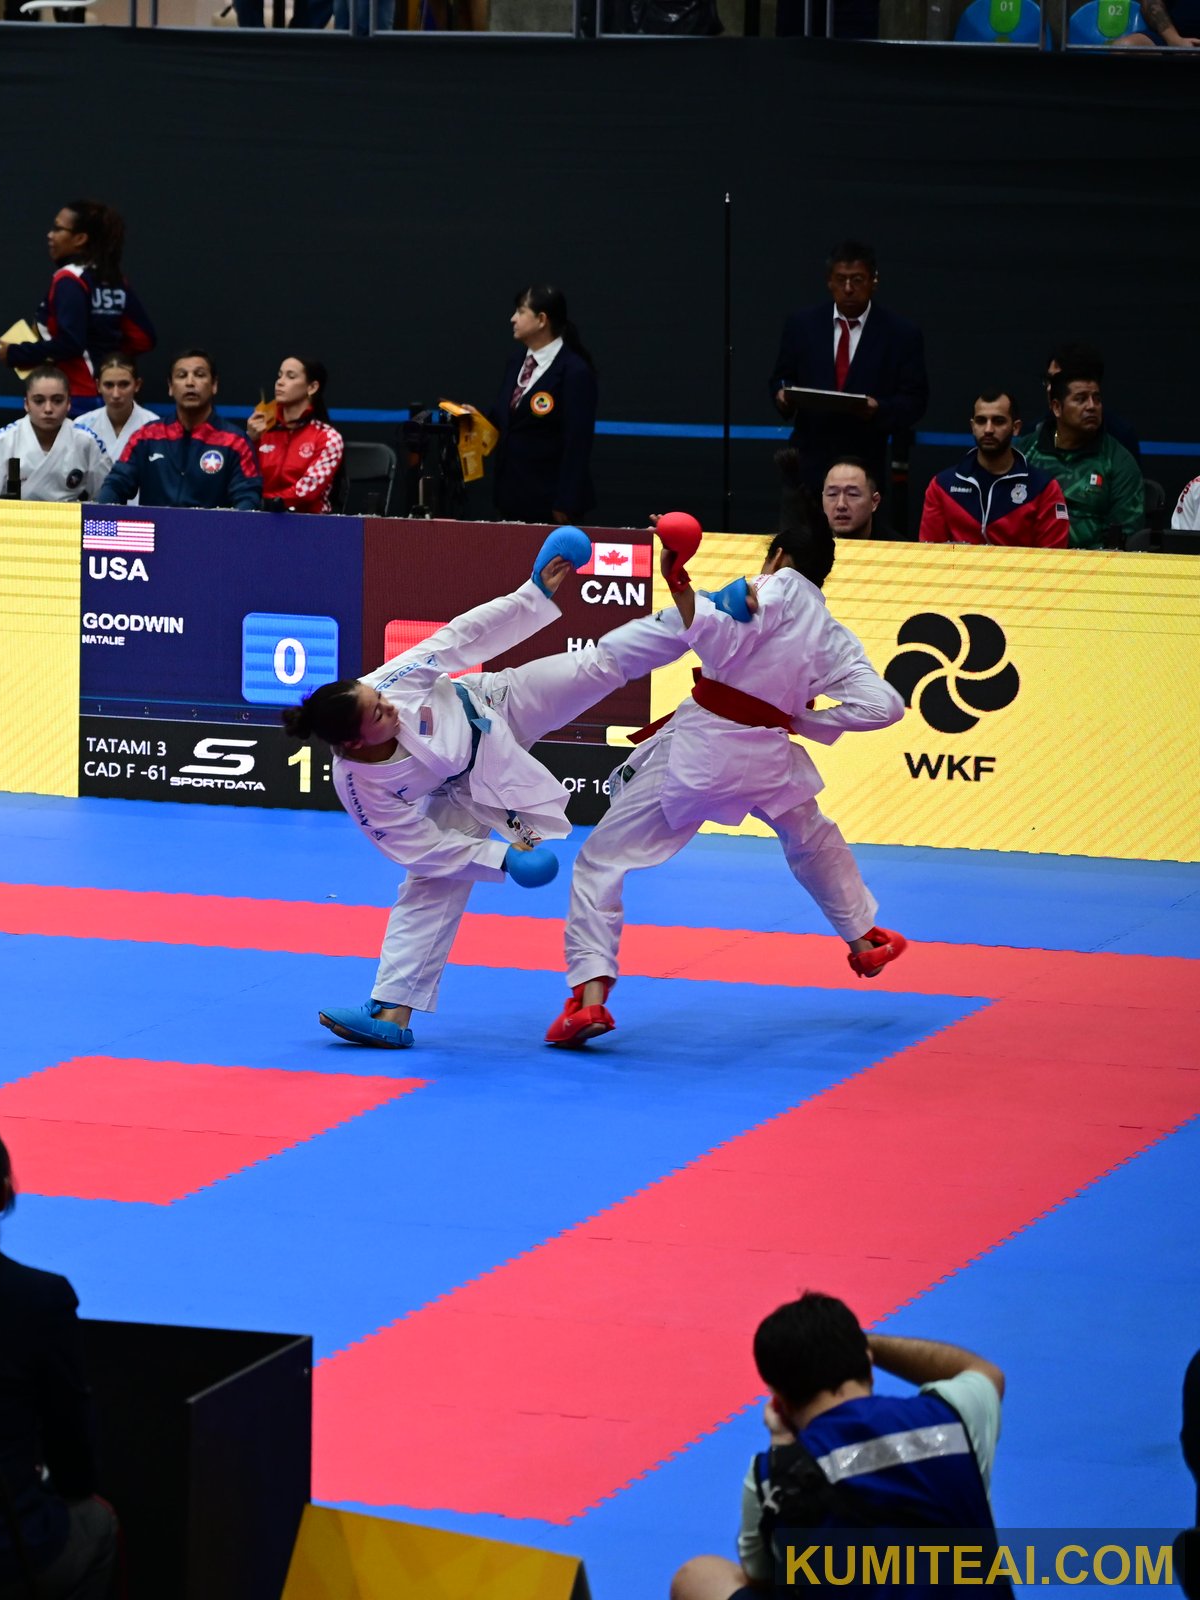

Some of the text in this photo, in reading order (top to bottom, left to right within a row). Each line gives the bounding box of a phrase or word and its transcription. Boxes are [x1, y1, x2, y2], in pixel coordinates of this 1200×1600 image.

[89, 556, 149, 582] USA
[581, 580, 645, 607] CAN
[82, 612, 184, 634] GOODWIN
[82, 634, 125, 646] NATALIE
[567, 637, 597, 653] HA
[274, 637, 306, 685] 0
[86, 737, 167, 757] TATAMI 3
[84, 761, 167, 781] CAD F -61
[288, 746, 330, 793] 1:
[904, 752, 997, 782] WKF
[169, 776, 266, 792] SPORTDATA
[561, 777, 587, 794] OF
